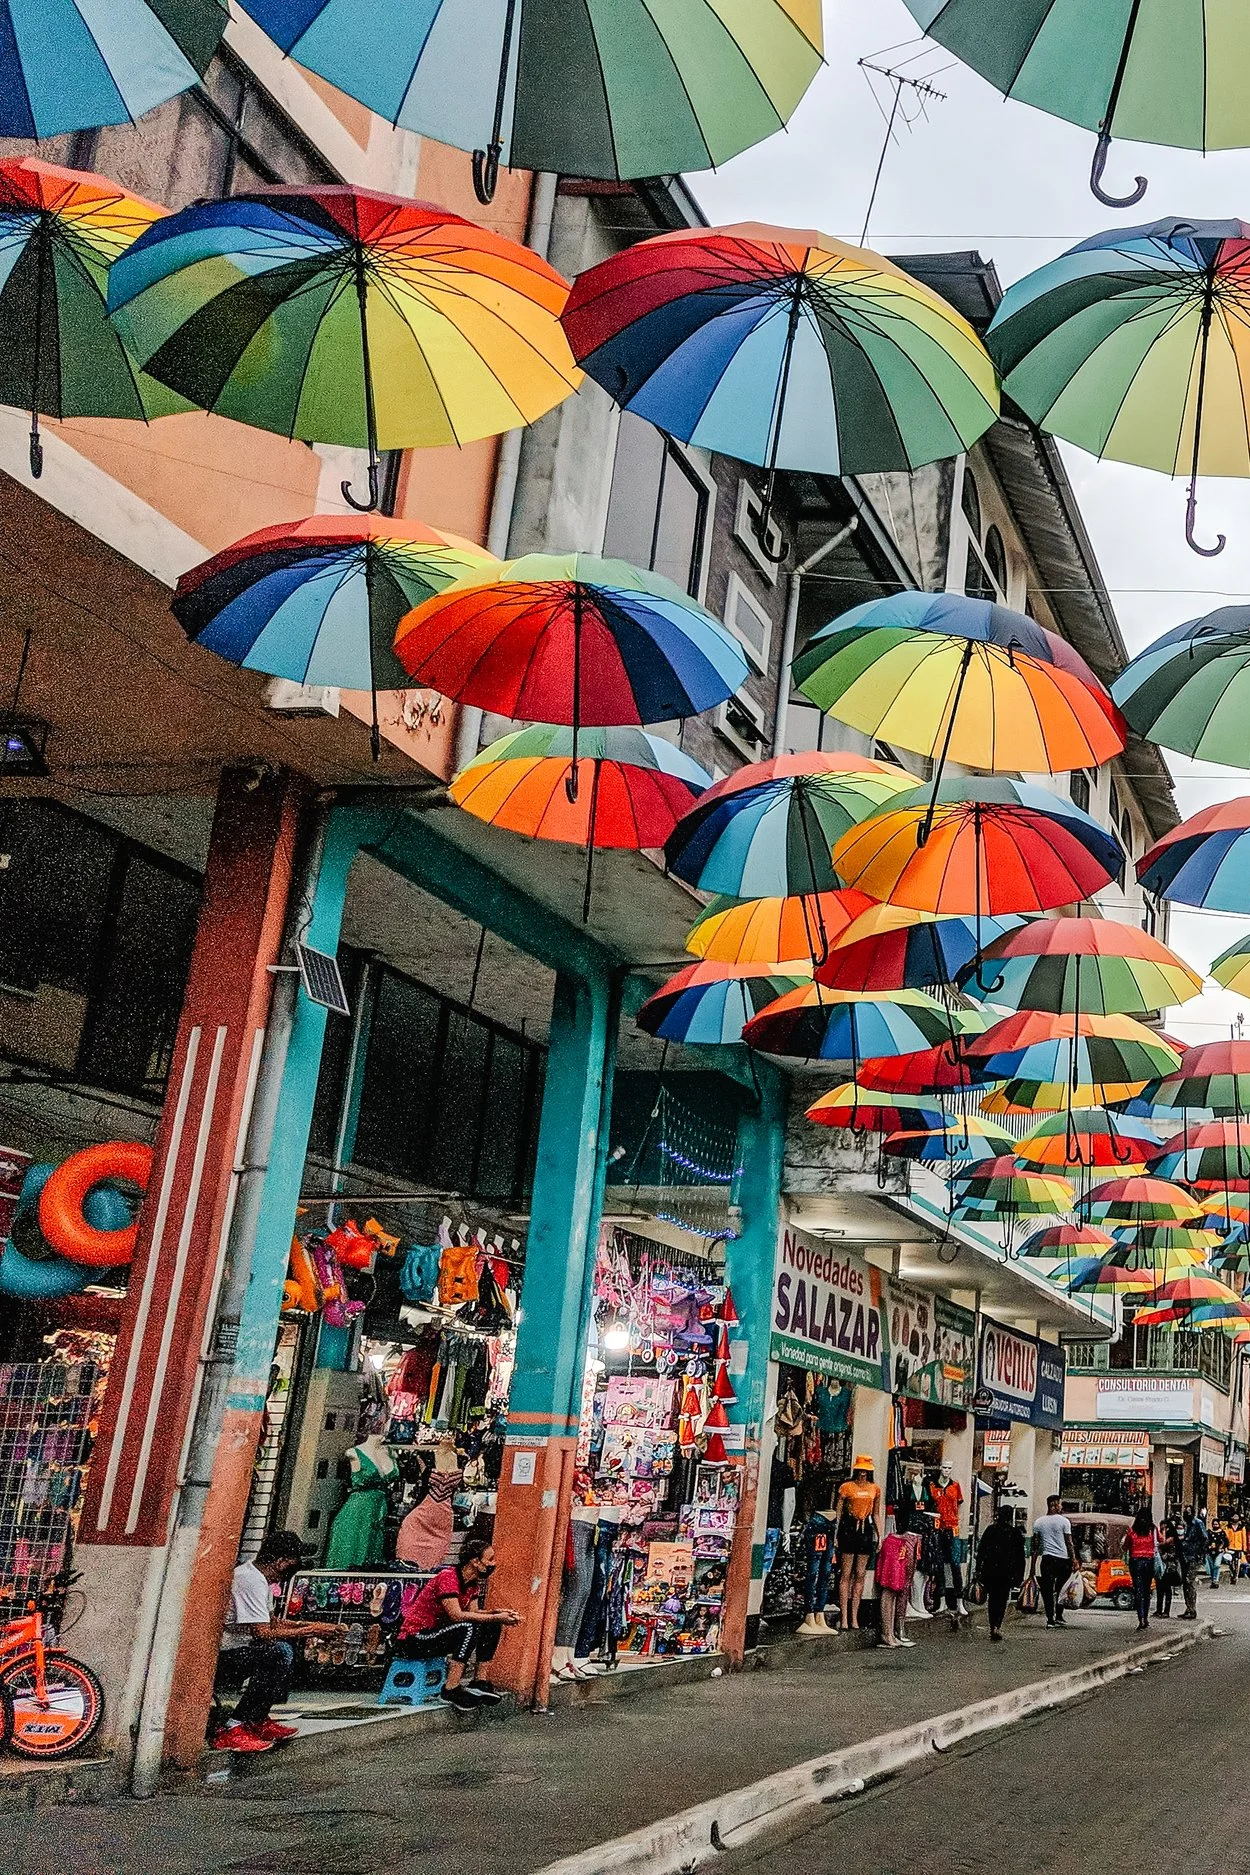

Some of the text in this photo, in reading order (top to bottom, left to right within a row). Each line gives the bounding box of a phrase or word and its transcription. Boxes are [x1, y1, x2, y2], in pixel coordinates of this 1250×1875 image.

[782, 1229, 864, 1297] Novedades
[775, 1271, 880, 1361] SALAZAR
[1098, 1378, 1191, 1391] CONSULTORIO DENTAL
